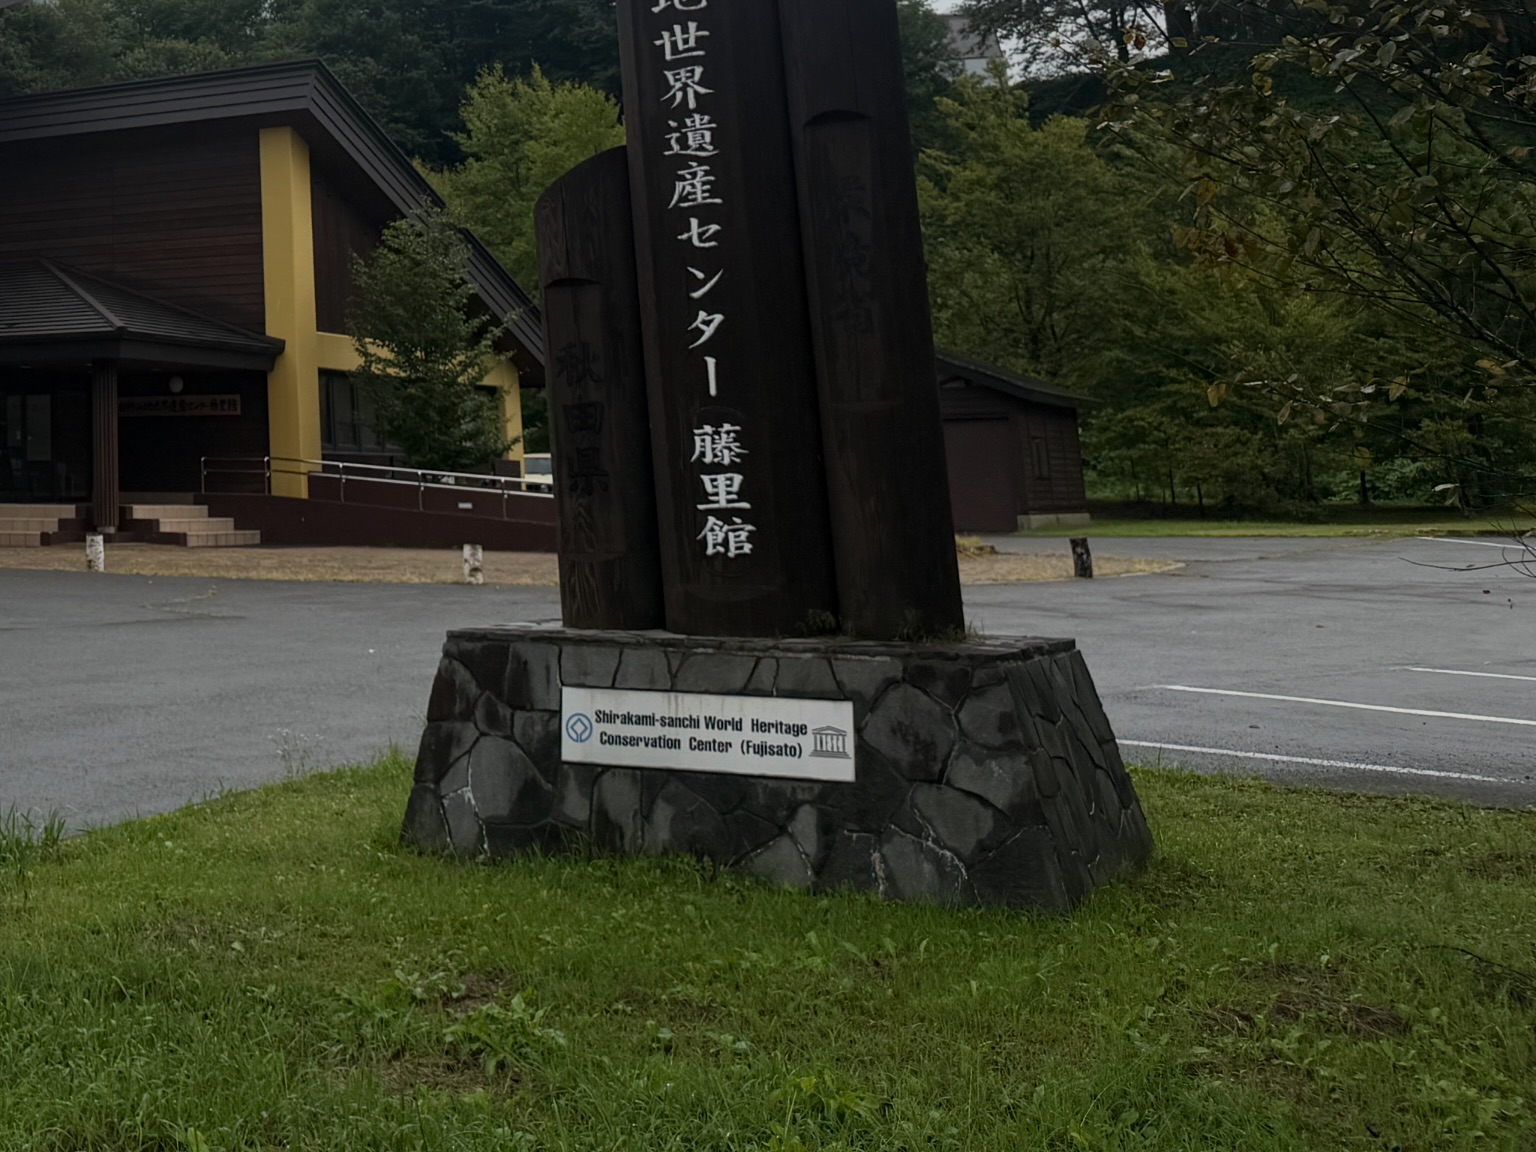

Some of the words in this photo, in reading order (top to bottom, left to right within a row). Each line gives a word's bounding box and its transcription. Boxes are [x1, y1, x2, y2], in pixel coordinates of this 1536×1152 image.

[555, 342, 609, 496] 秋田県
[594, 709, 700, 729] Shirakami-sanchi
[704, 715, 743, 732] World
[750, 718, 808, 737] Heritage
[599, 731, 681, 750] Conservation
[689, 736, 732, 753] Center
[740, 739, 803, 759] (Fujisato)
